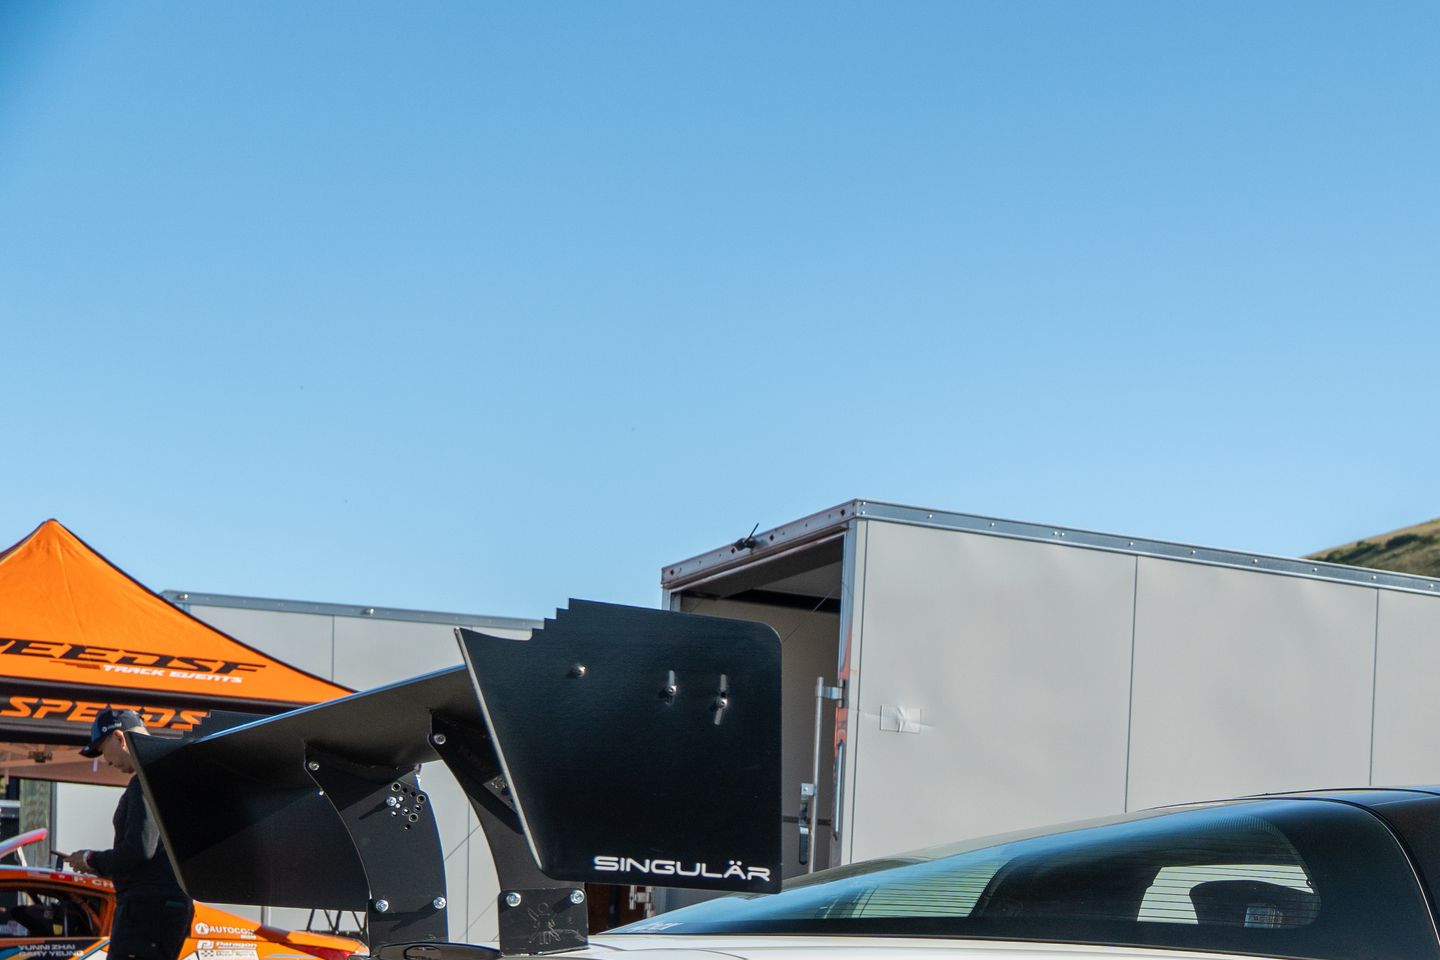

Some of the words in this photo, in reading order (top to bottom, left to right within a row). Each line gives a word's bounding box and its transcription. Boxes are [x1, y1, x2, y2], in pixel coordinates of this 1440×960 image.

[0, 637, 266, 675] EEDSF
[103, 664, 164, 677] TRACK
[168, 671, 244, 685] EVENTS
[0, 696, 208, 731] SPEDS
[593, 855, 771, 882] SINGULÄR
